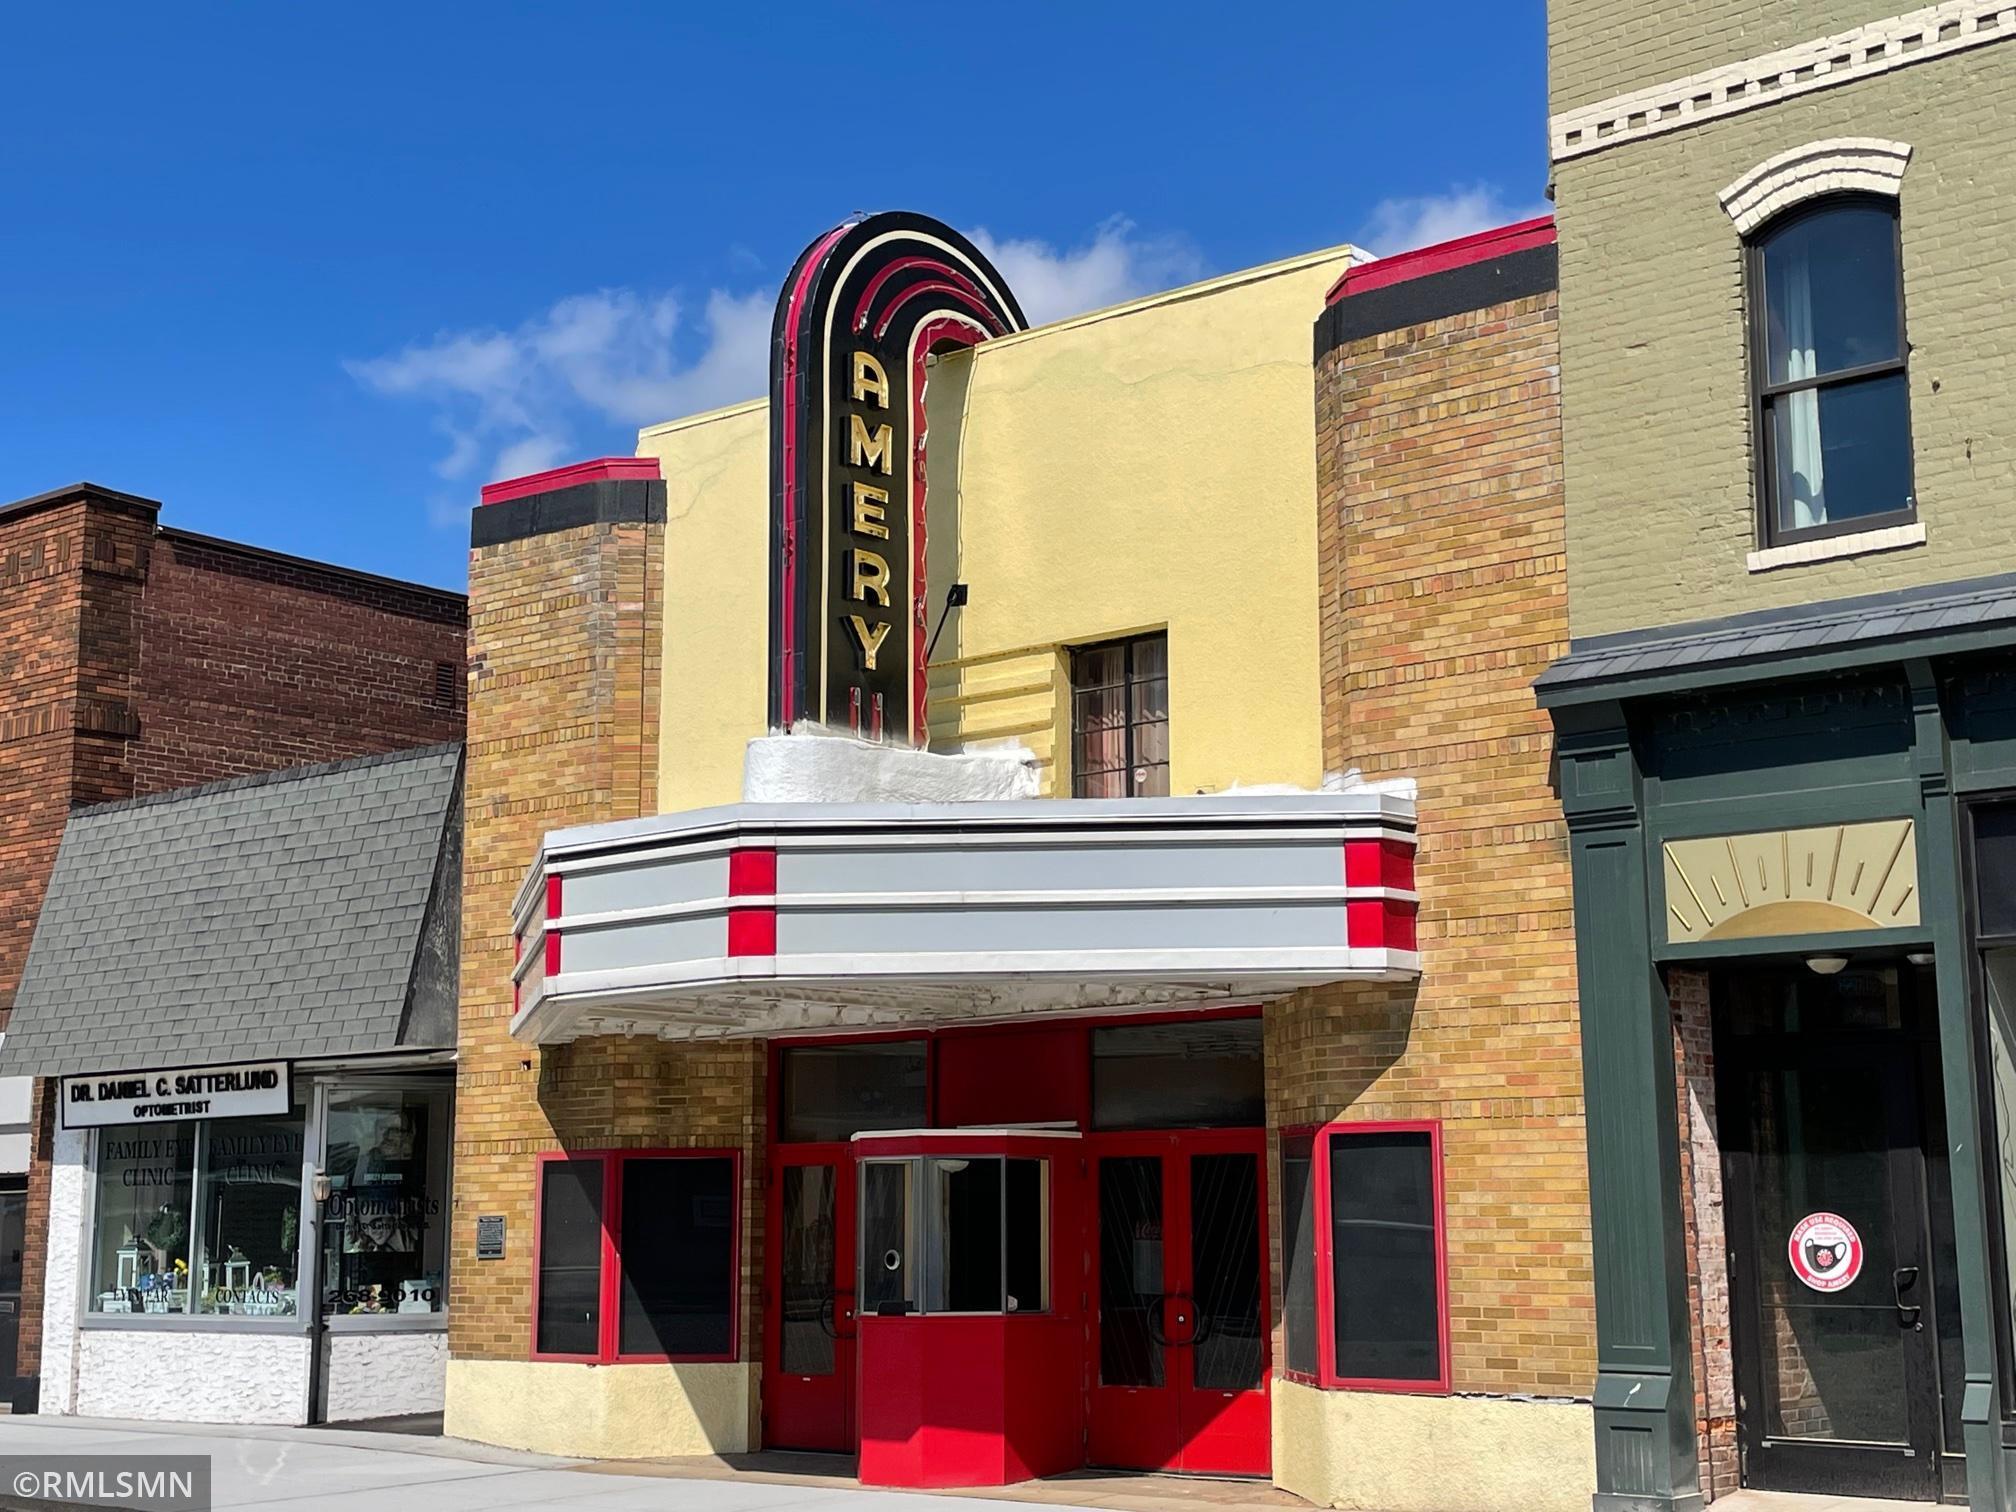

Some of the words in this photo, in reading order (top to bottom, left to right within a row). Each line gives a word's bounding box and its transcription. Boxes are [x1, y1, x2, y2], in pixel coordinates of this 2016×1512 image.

[850, 351, 893, 670] AMERY
[71, 1084, 94, 1102] DR.
[98, 1079, 152, 1101] DANIEL
[156, 1077, 171, 1096] C.
[174, 1070, 278, 1094] SATTERLUND
[133, 1100, 211, 1117] OPTOMETRIST
[106, 1140, 161, 1160] FAMILY
[122, 1167, 174, 1187] CLINIC
[226, 1162, 283, 1184] CLINIC
[330, 1194, 440, 1218] Optometrists
[215, 1289, 279, 1304] CONTACTS
